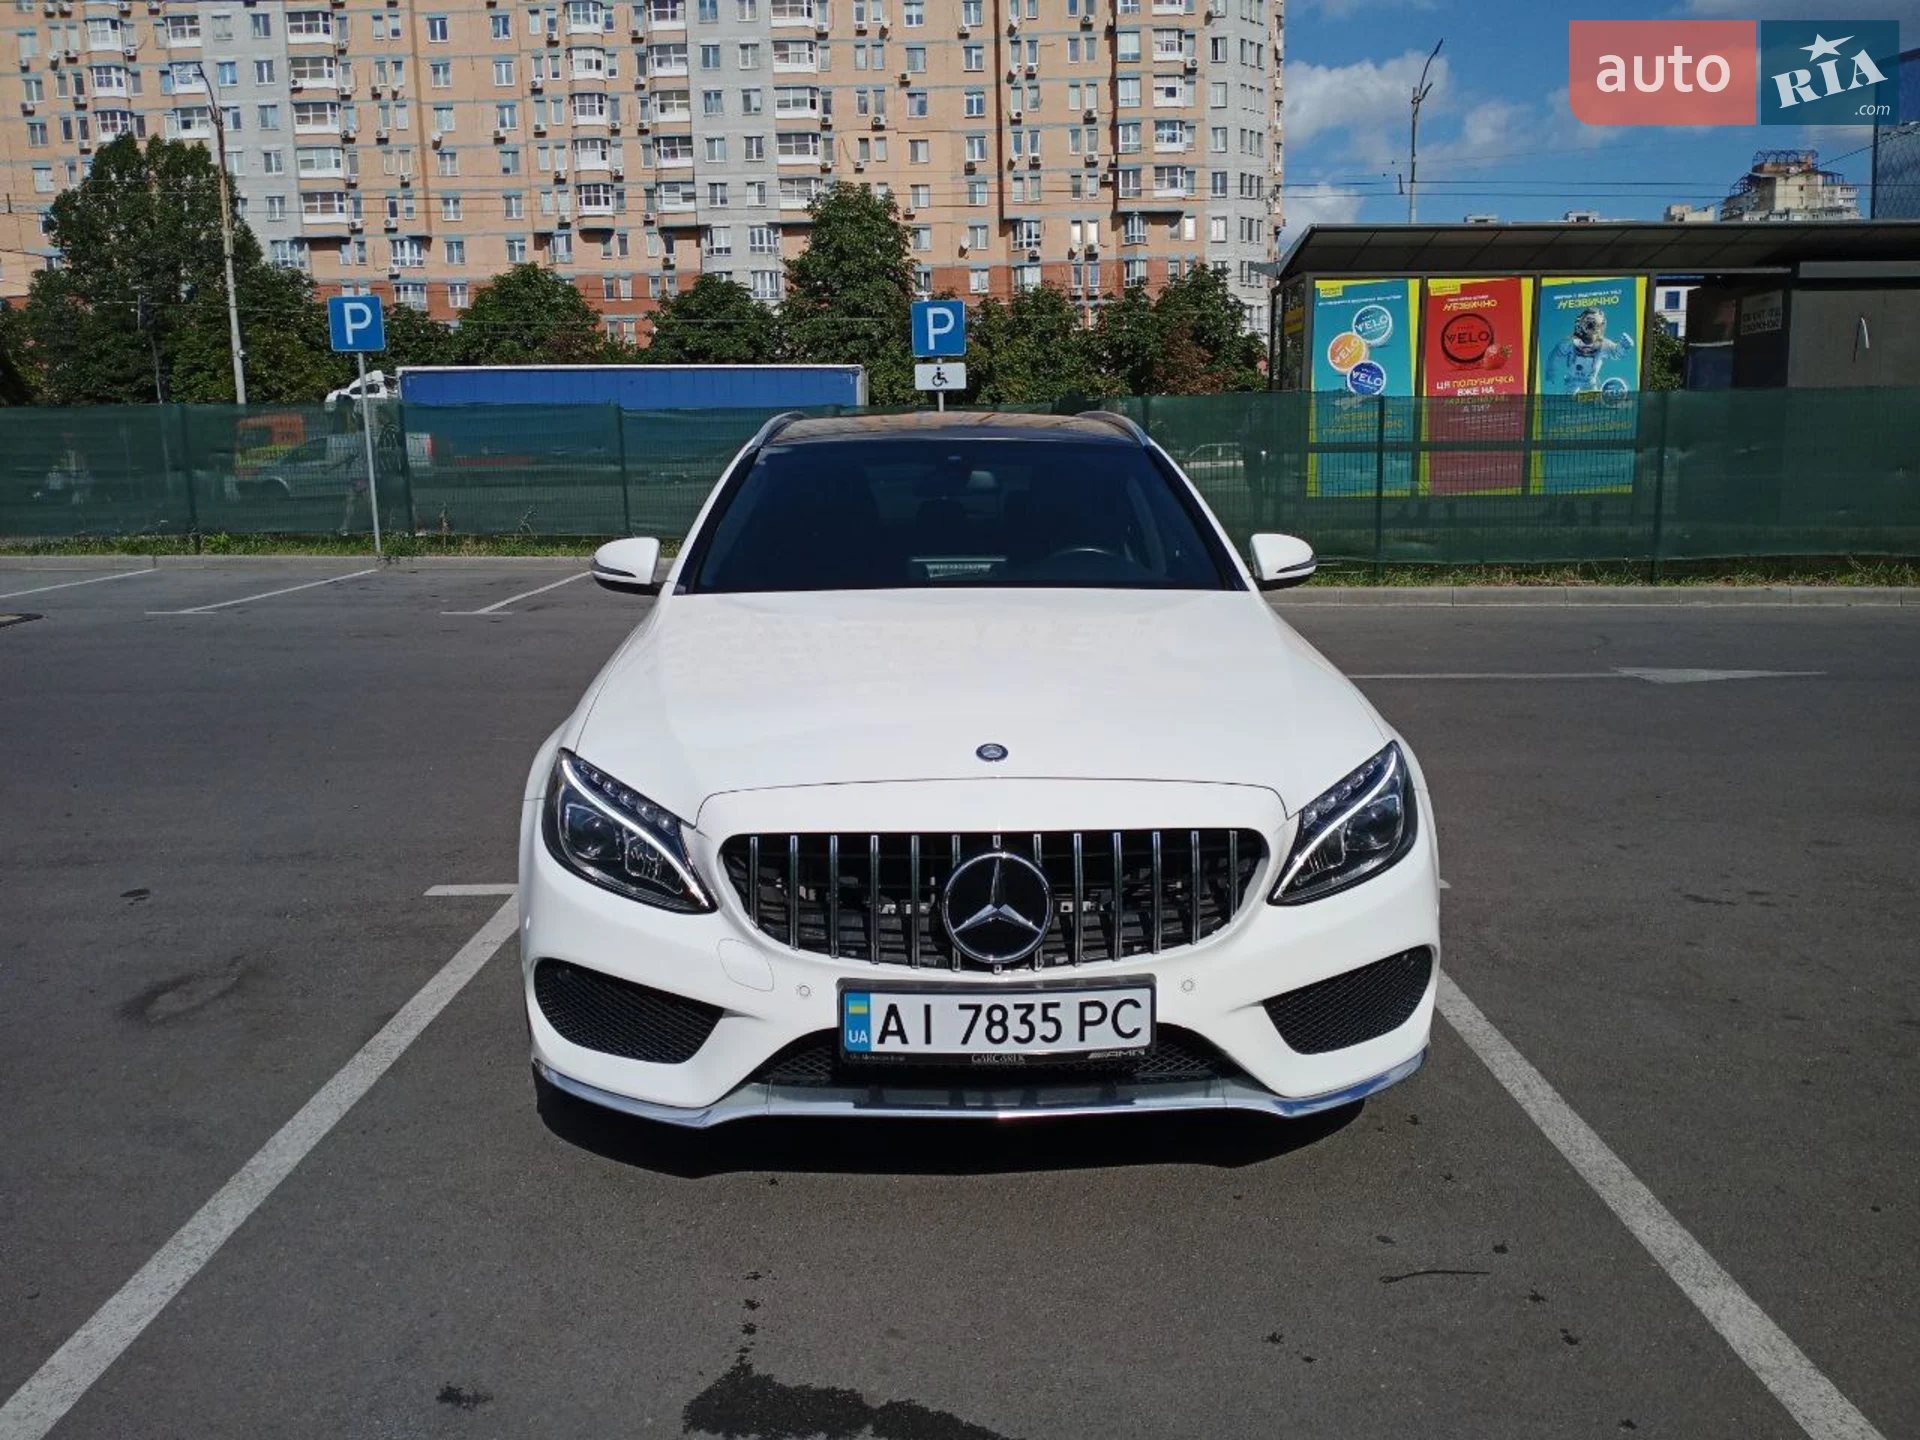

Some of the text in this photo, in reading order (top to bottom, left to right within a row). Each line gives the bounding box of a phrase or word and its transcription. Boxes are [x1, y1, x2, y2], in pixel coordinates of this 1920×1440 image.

[344, 302, 372, 345] P
[927, 307, 955, 350] P
[1355, 315, 1389, 332] VELO
[1445, 331, 1490, 345] VELO
[1332, 337, 1360, 364] VELO
[1351, 370, 1383, 387] VELO
[1457, 386, 1495, 396] ВЖЕ НА
[877, 998, 1142, 1045] AI 7835 PC
[848, 1030, 869, 1044] UA
